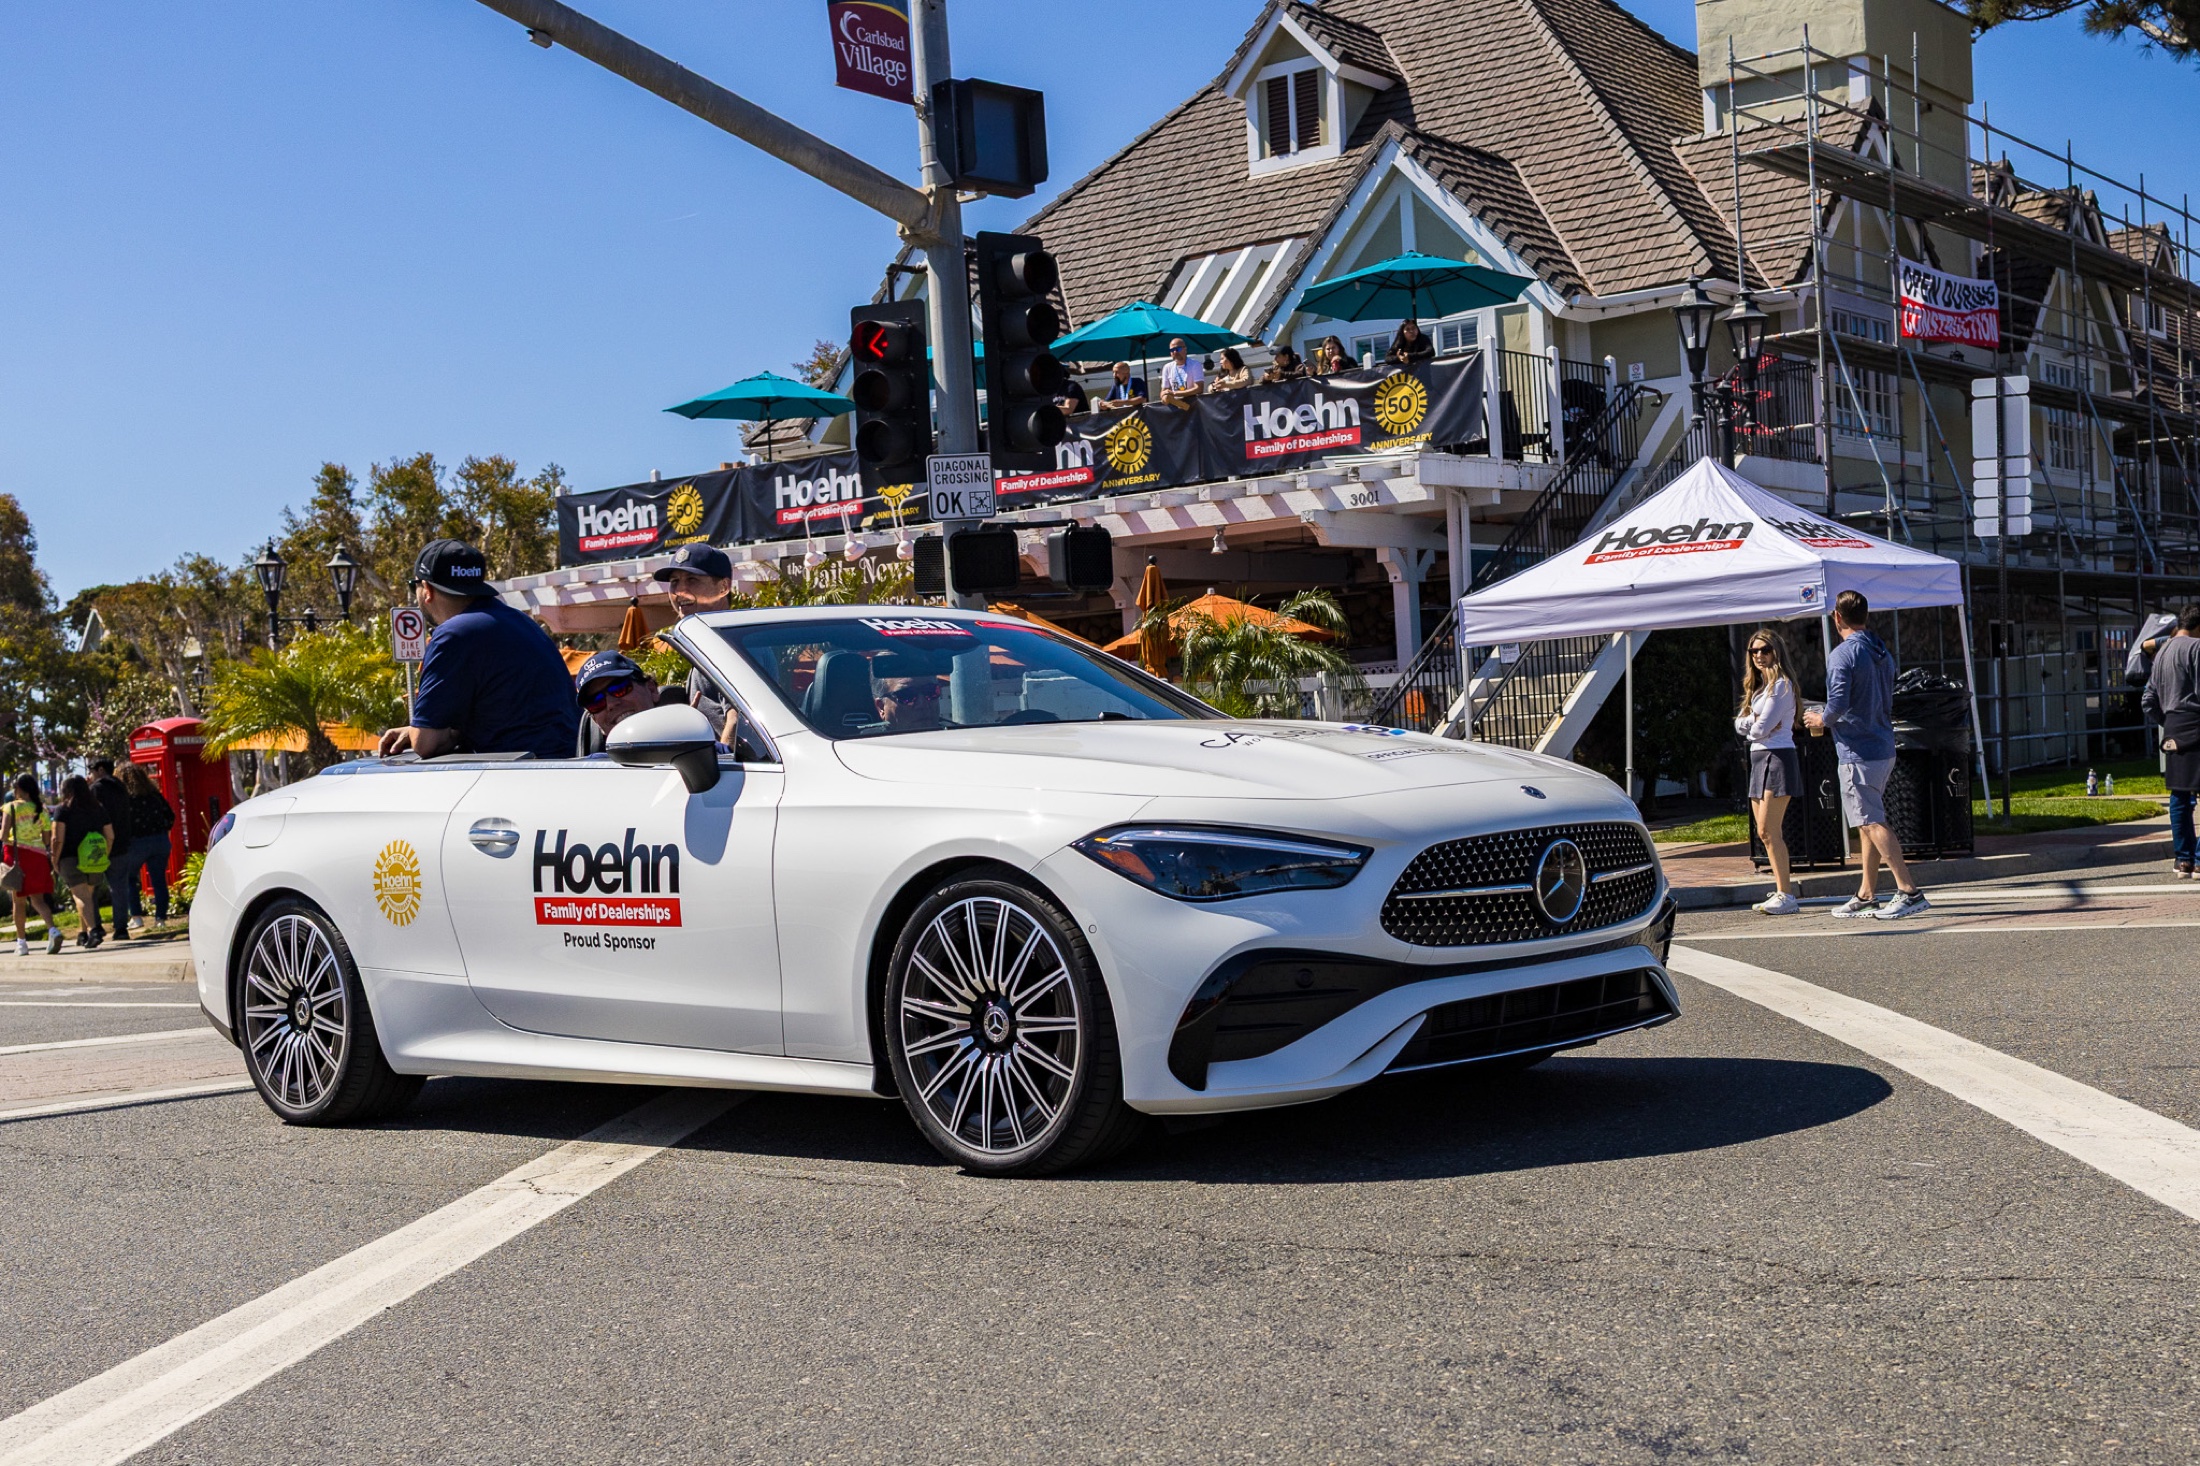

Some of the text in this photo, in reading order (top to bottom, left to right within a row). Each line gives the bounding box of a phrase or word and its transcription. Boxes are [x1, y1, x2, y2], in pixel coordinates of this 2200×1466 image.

[856, 27, 905, 51] Carlsbad
[838, 42, 907, 86] Village
[1903, 265, 1942, 306] OPEN
[1904, 303, 1999, 342] CONSTRUCTION
[1243, 392, 1361, 441] Hoehn
[1254, 431, 1353, 455] Family of Dealerships
[1370, 432, 1433, 450] ANNIVERSARY
[933, 459, 988, 472] DIAGONAL
[935, 471, 989, 485] CROSSING
[1001, 471, 1088, 491] Family of Dealerships
[1102, 473, 1161, 489] ANNIVERSARY
[774, 468, 863, 509] Hoehn
[1350, 490, 1379, 506] 3001
[936, 491, 964, 515] OK
[577, 499, 658, 537] Hoehn
[584, 531, 654, 549] Family of Dealerships
[1591, 517, 1754, 554] Hoehn
[1594, 542, 1732, 562] Family of Dealerships
[451, 565, 482, 577] Hoehn
[786, 562, 803, 577] the
[858, 555, 915, 585] News
[858, 616, 964, 631] Hoehn
[401, 641, 420, 650] BIKE
[401, 650, 422, 658] LANE
[532, 827, 680, 895] Hoehn
[381, 872, 412, 888] Hoehn
[543, 902, 671, 924] Family of Dealerships
[563, 932, 656, 952] Proud Sponsor
